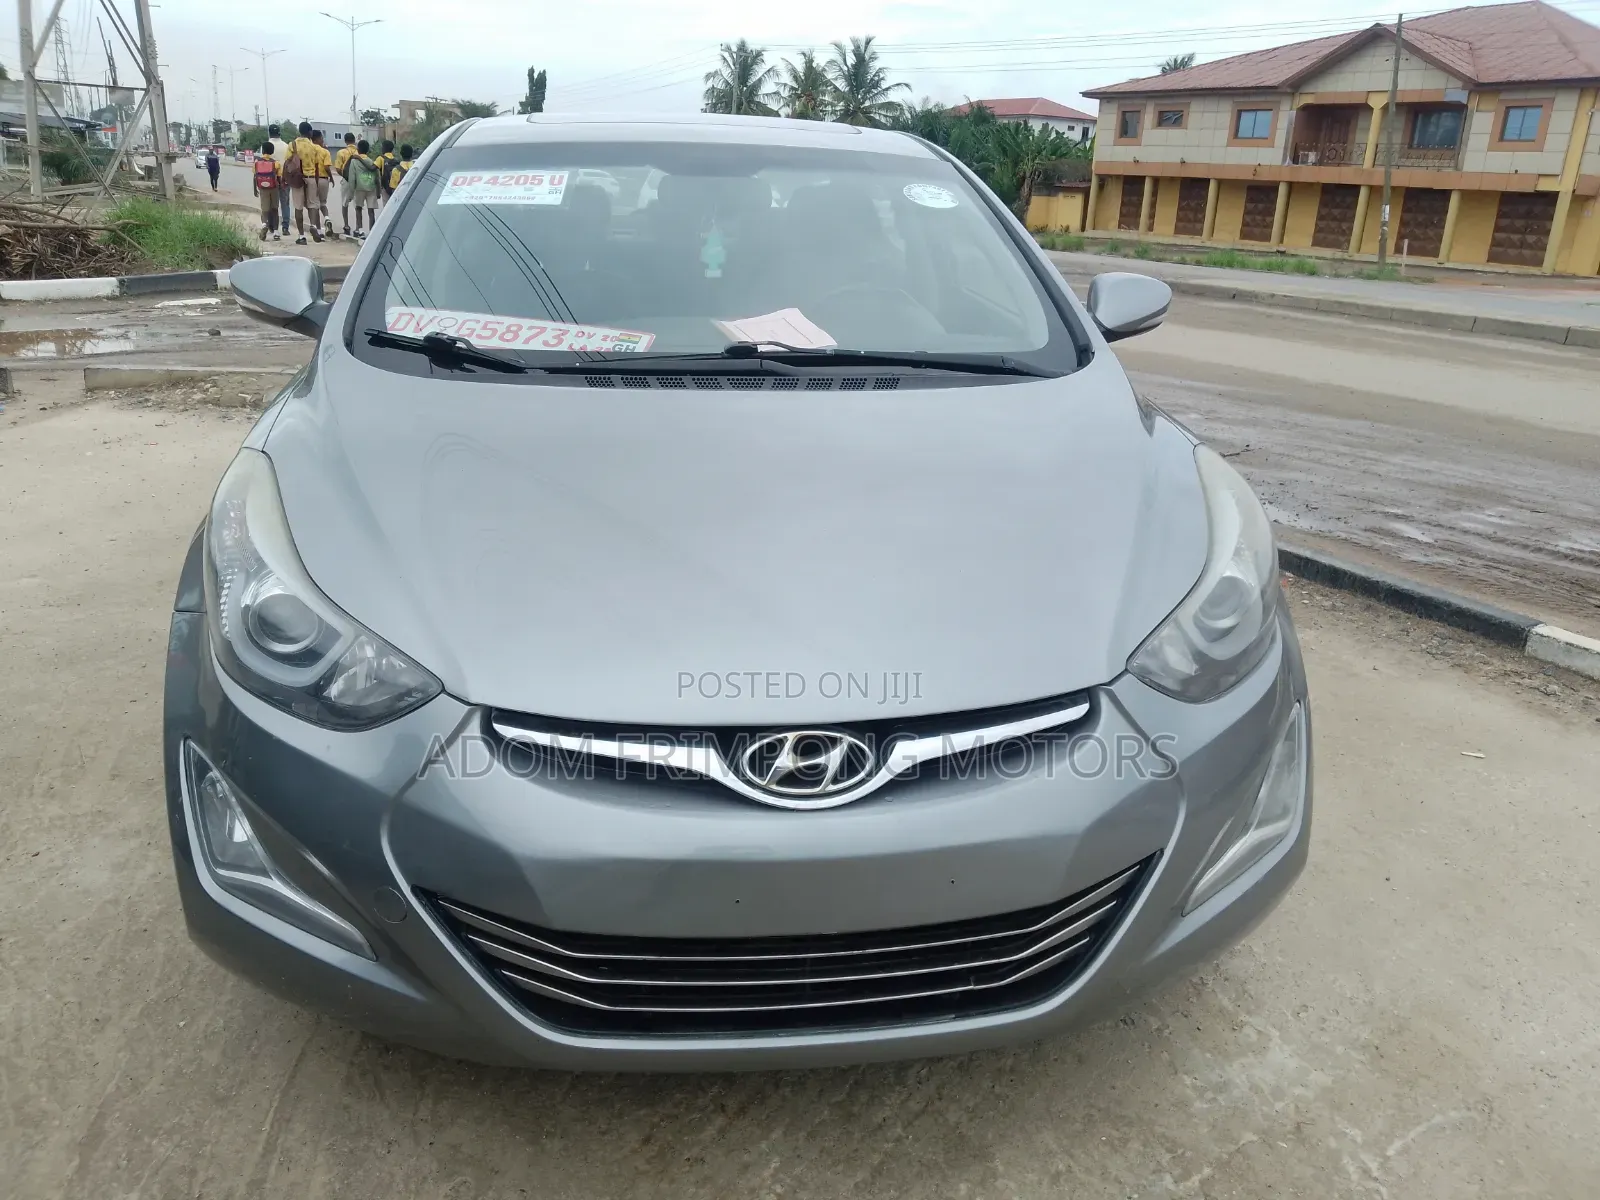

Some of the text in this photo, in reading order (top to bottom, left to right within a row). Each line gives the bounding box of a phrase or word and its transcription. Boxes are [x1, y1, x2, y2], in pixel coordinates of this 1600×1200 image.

[483, 174, 545, 187] 4205
[549, 174, 565, 186] U
[387, 312, 439, 334] DV
[612, 343, 637, 353] GH
